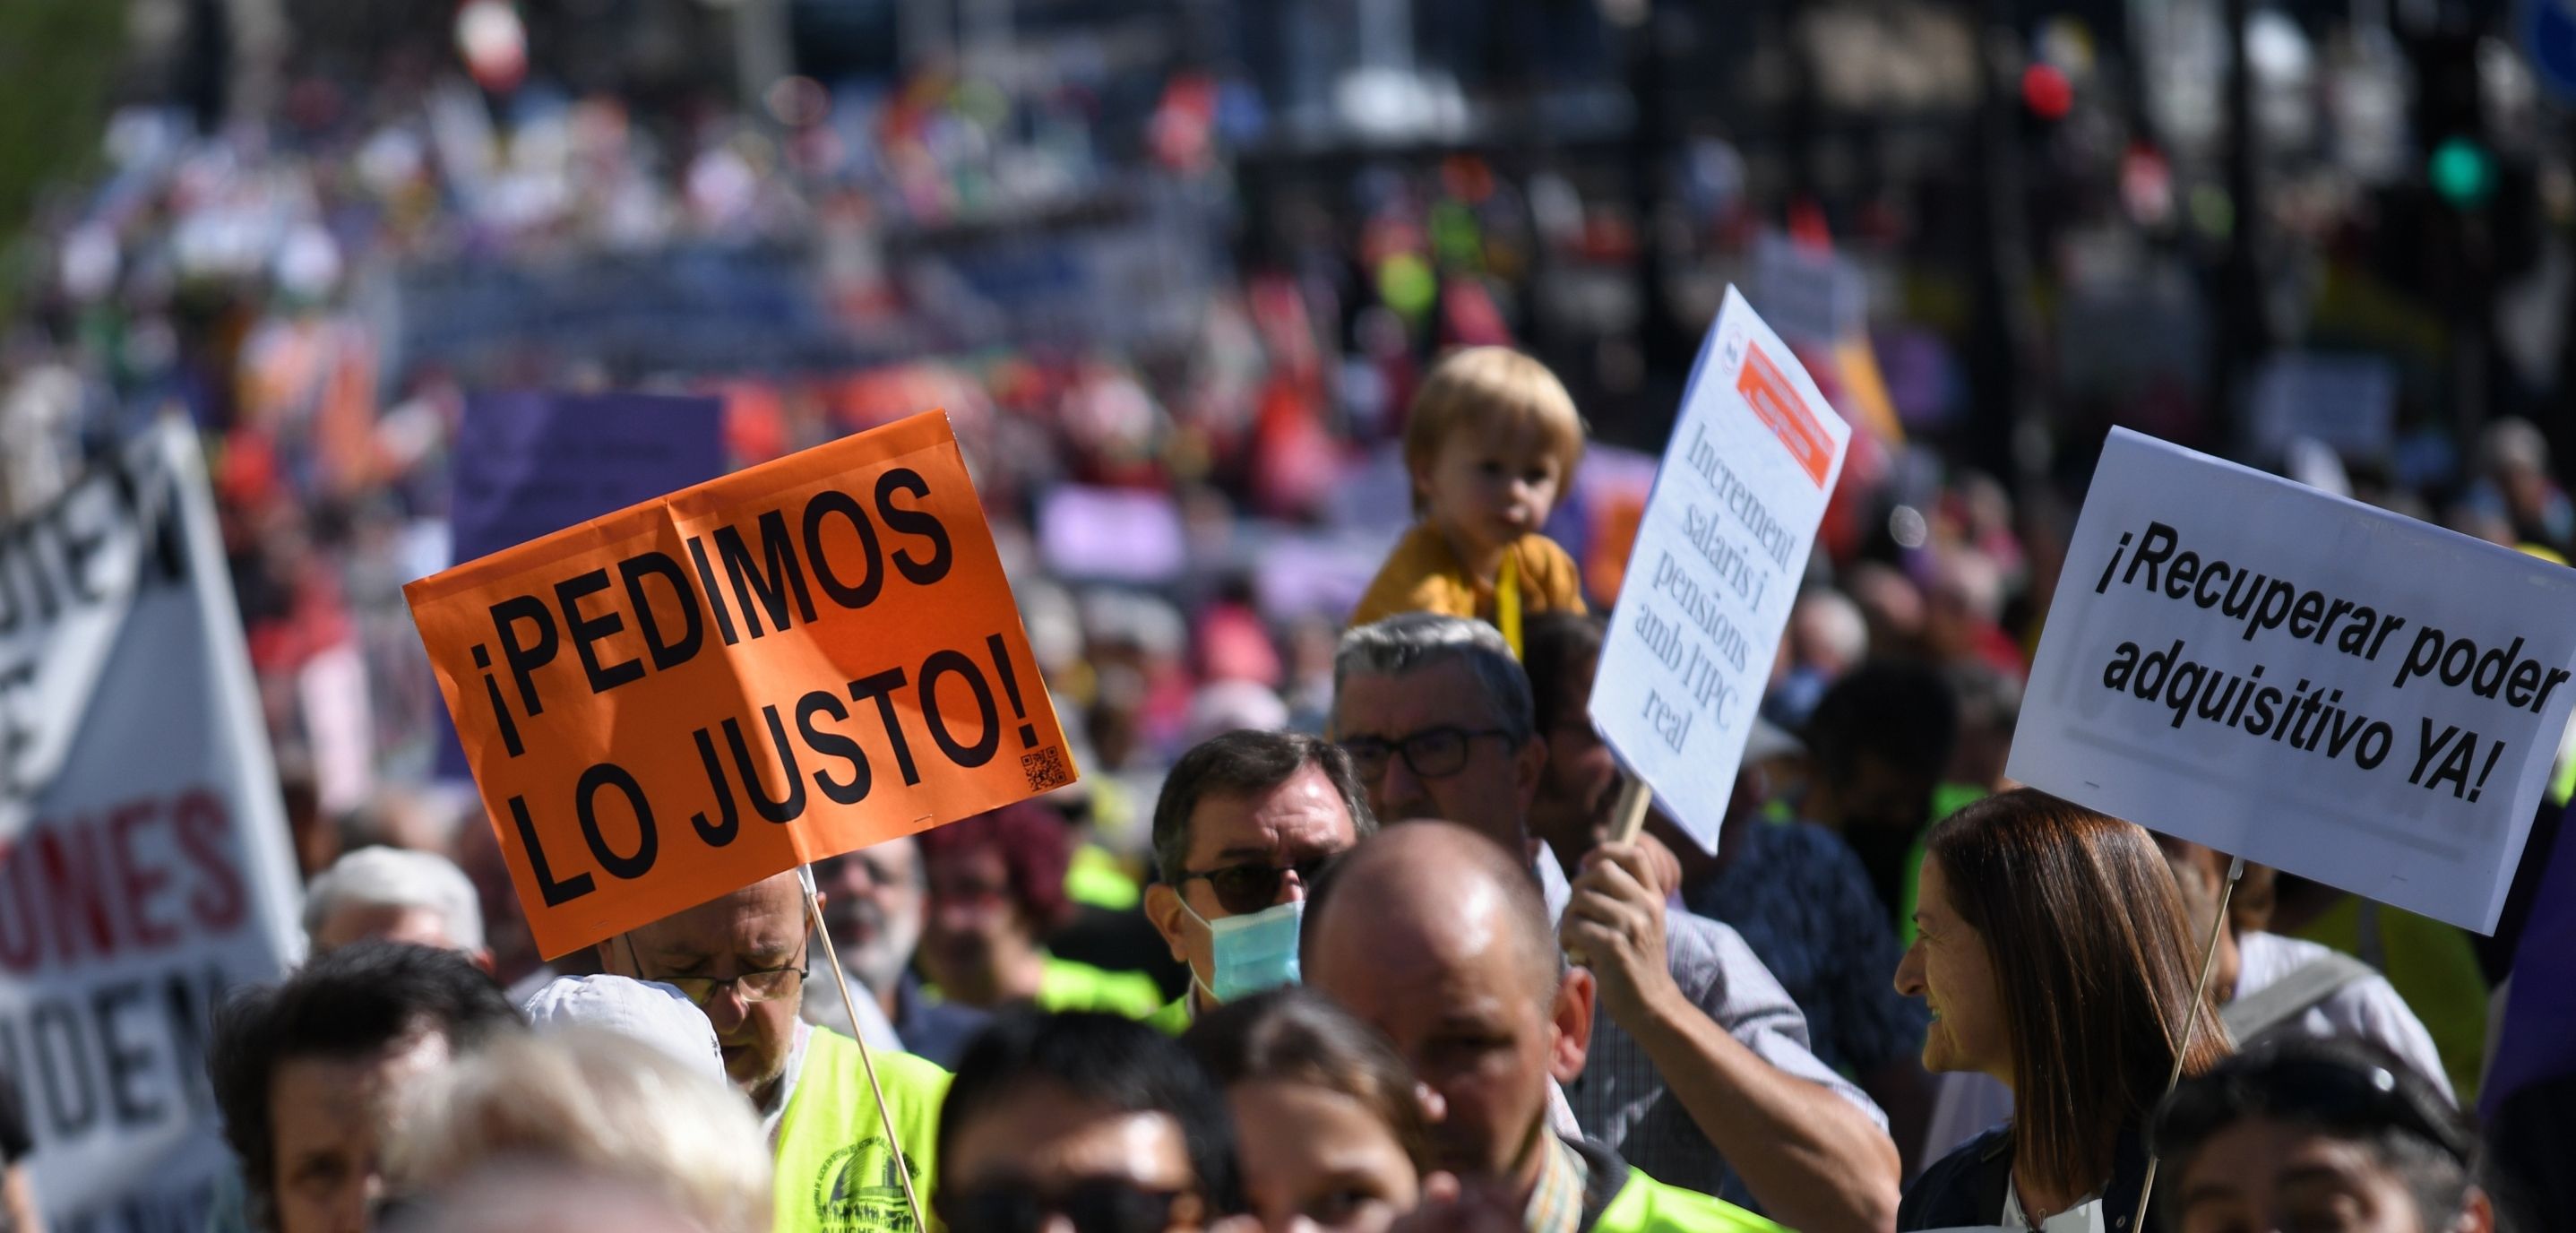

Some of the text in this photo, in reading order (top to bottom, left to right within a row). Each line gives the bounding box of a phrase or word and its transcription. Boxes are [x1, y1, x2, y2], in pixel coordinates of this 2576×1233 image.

[1682, 504, 1753, 599] salaris
[1685, 421, 1796, 573] Increment
[470, 468, 953, 758] ¡PEDIMOS
[1634, 603, 1684, 672] amb
[1652, 548, 1750, 673] pensions
[2095, 522, 2571, 714] ¡Recuperar poder
[507, 634, 1039, 908] LO JUSTO!
[1641, 687, 1693, 754] real
[2103, 639, 2506, 804] adquisitivo YA!
